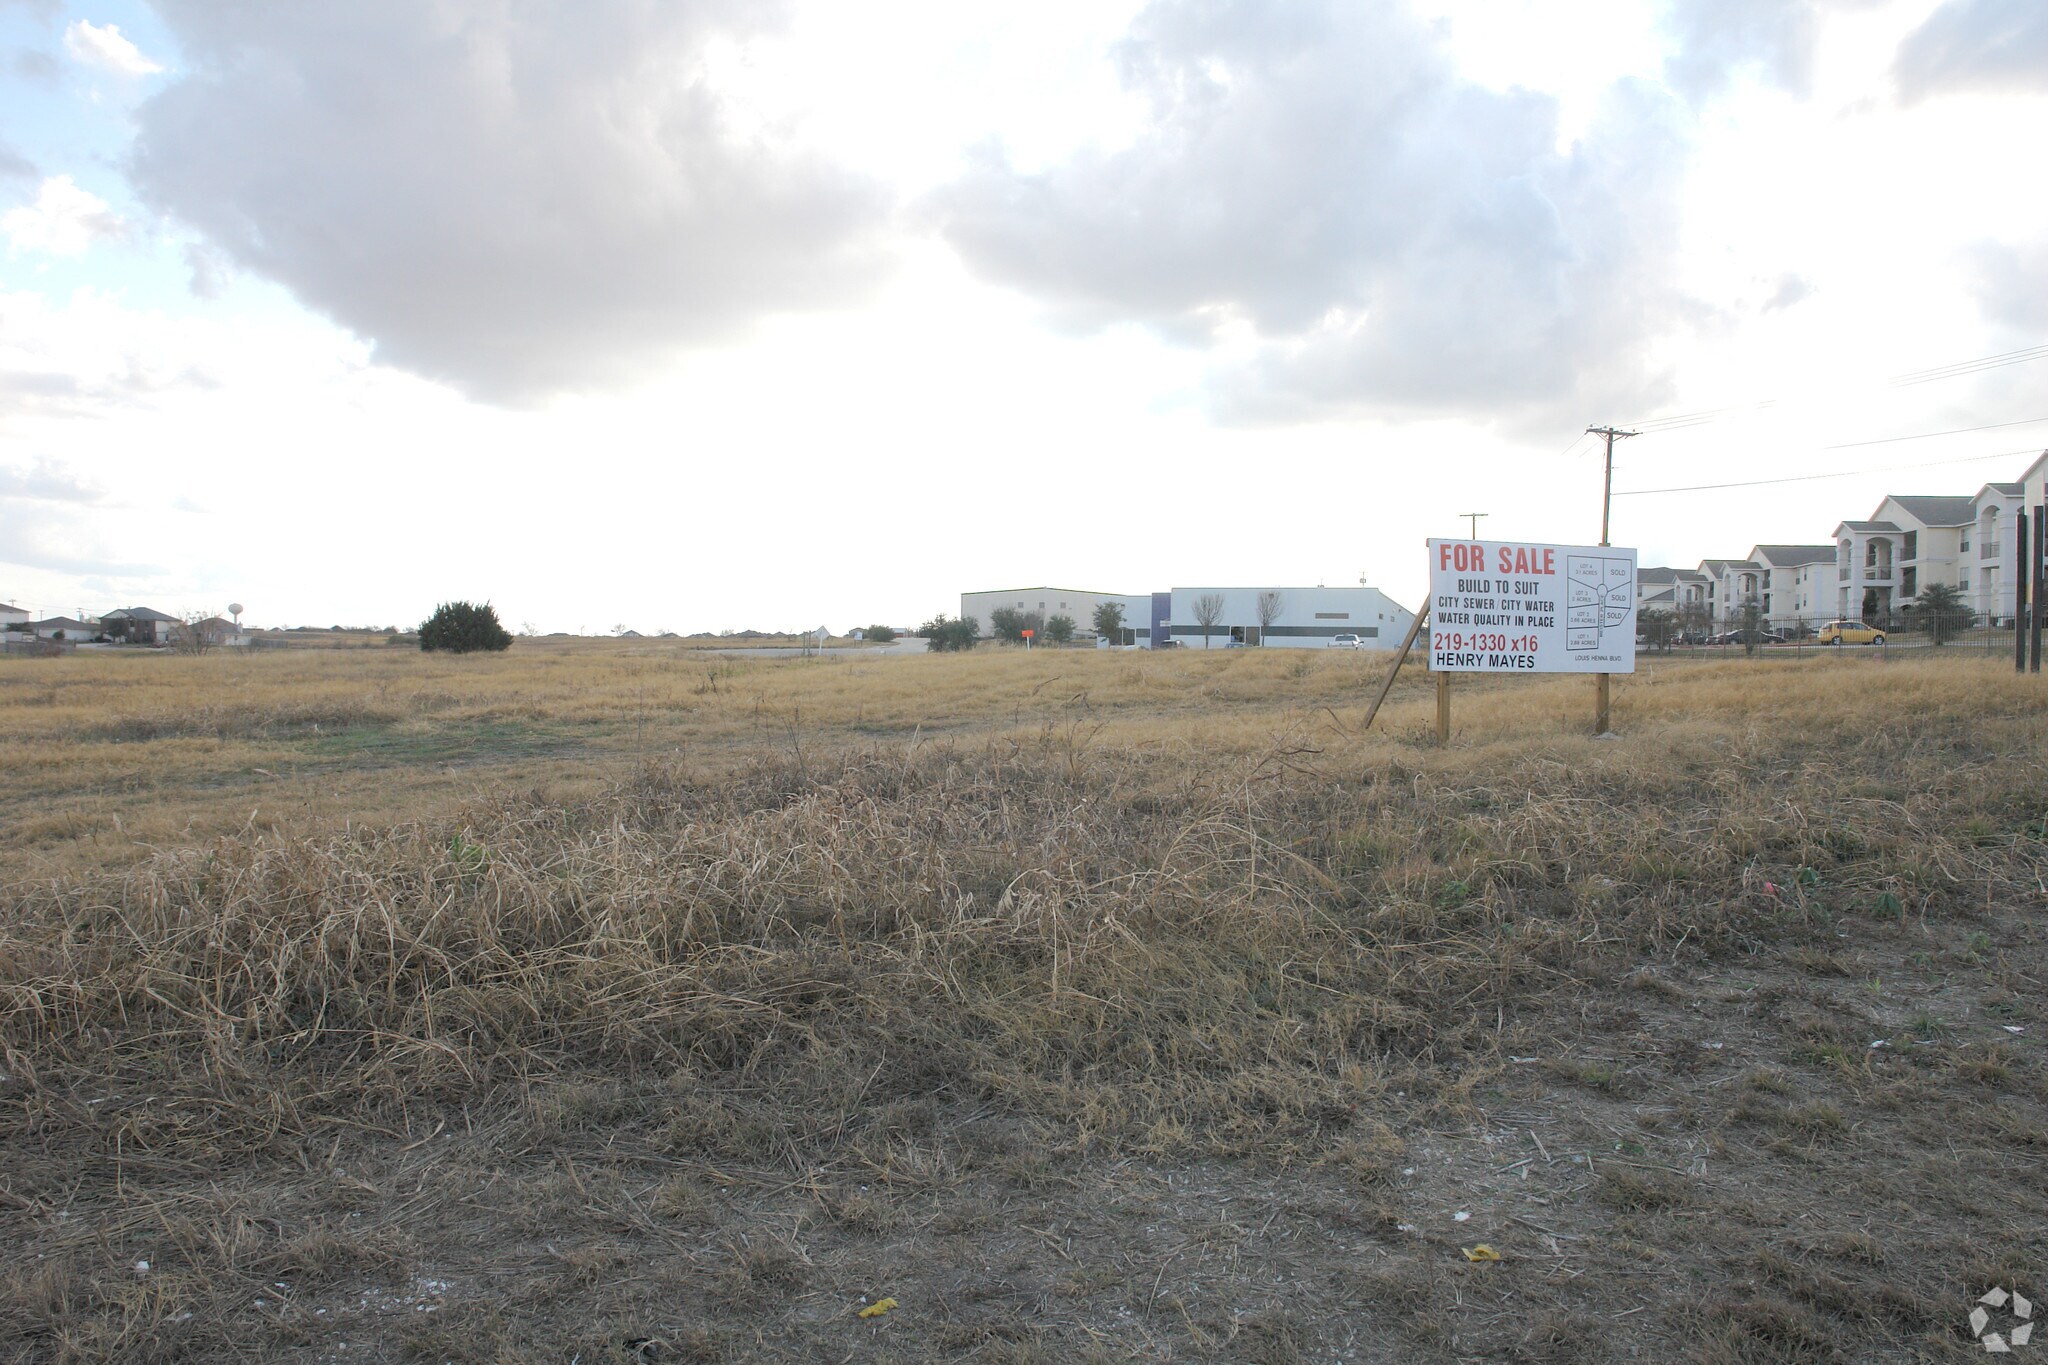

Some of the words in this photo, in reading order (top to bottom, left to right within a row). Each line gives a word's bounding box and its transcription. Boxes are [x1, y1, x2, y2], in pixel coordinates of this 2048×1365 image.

[1440, 544, 1485, 572] FOR
[1499, 546, 1555, 575] SALE
[1458, 578, 1490, 593] BUILD
[1495, 580, 1509, 594] TO
[1515, 581, 1539, 595] SUIT
[1438, 596, 1460, 608] CITY
[1463, 597, 1495, 610] SEWER
[1501, 599, 1521, 611] CITY
[1525, 601, 1554, 613] WATER
[1611, 594, 1627, 602] SOLD
[1438, 612, 1470, 625] WATER
[1474, 613, 1511, 627] QUALITY
[1515, 615, 1524, 627] IN
[1528, 616, 1554, 628] PLACE
[1606, 611, 1622, 620] SOLD
[1434, 632, 1506, 651] 219-1330
[1511, 635, 1538, 652] x16
[1436, 652, 1483, 666] HENRY
[1489, 654, 1535, 669] MAYES
